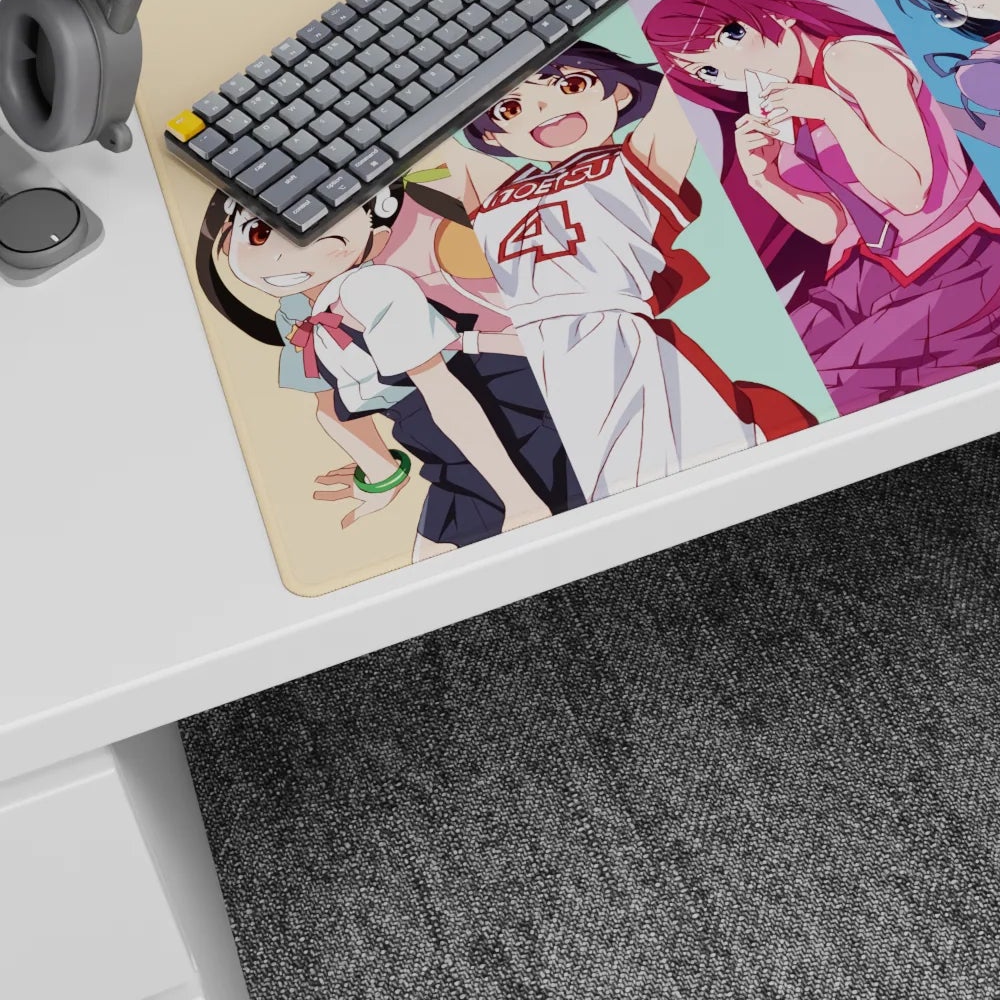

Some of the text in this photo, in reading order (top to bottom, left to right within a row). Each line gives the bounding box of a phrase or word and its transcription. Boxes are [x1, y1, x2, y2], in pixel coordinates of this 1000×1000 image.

[354, 148, 378, 167] command
[284, 174, 297, 184] shift
[326, 176, 343, 188] option
[292, 199, 310, 214] control
[498, 200, 586, 264] 4
